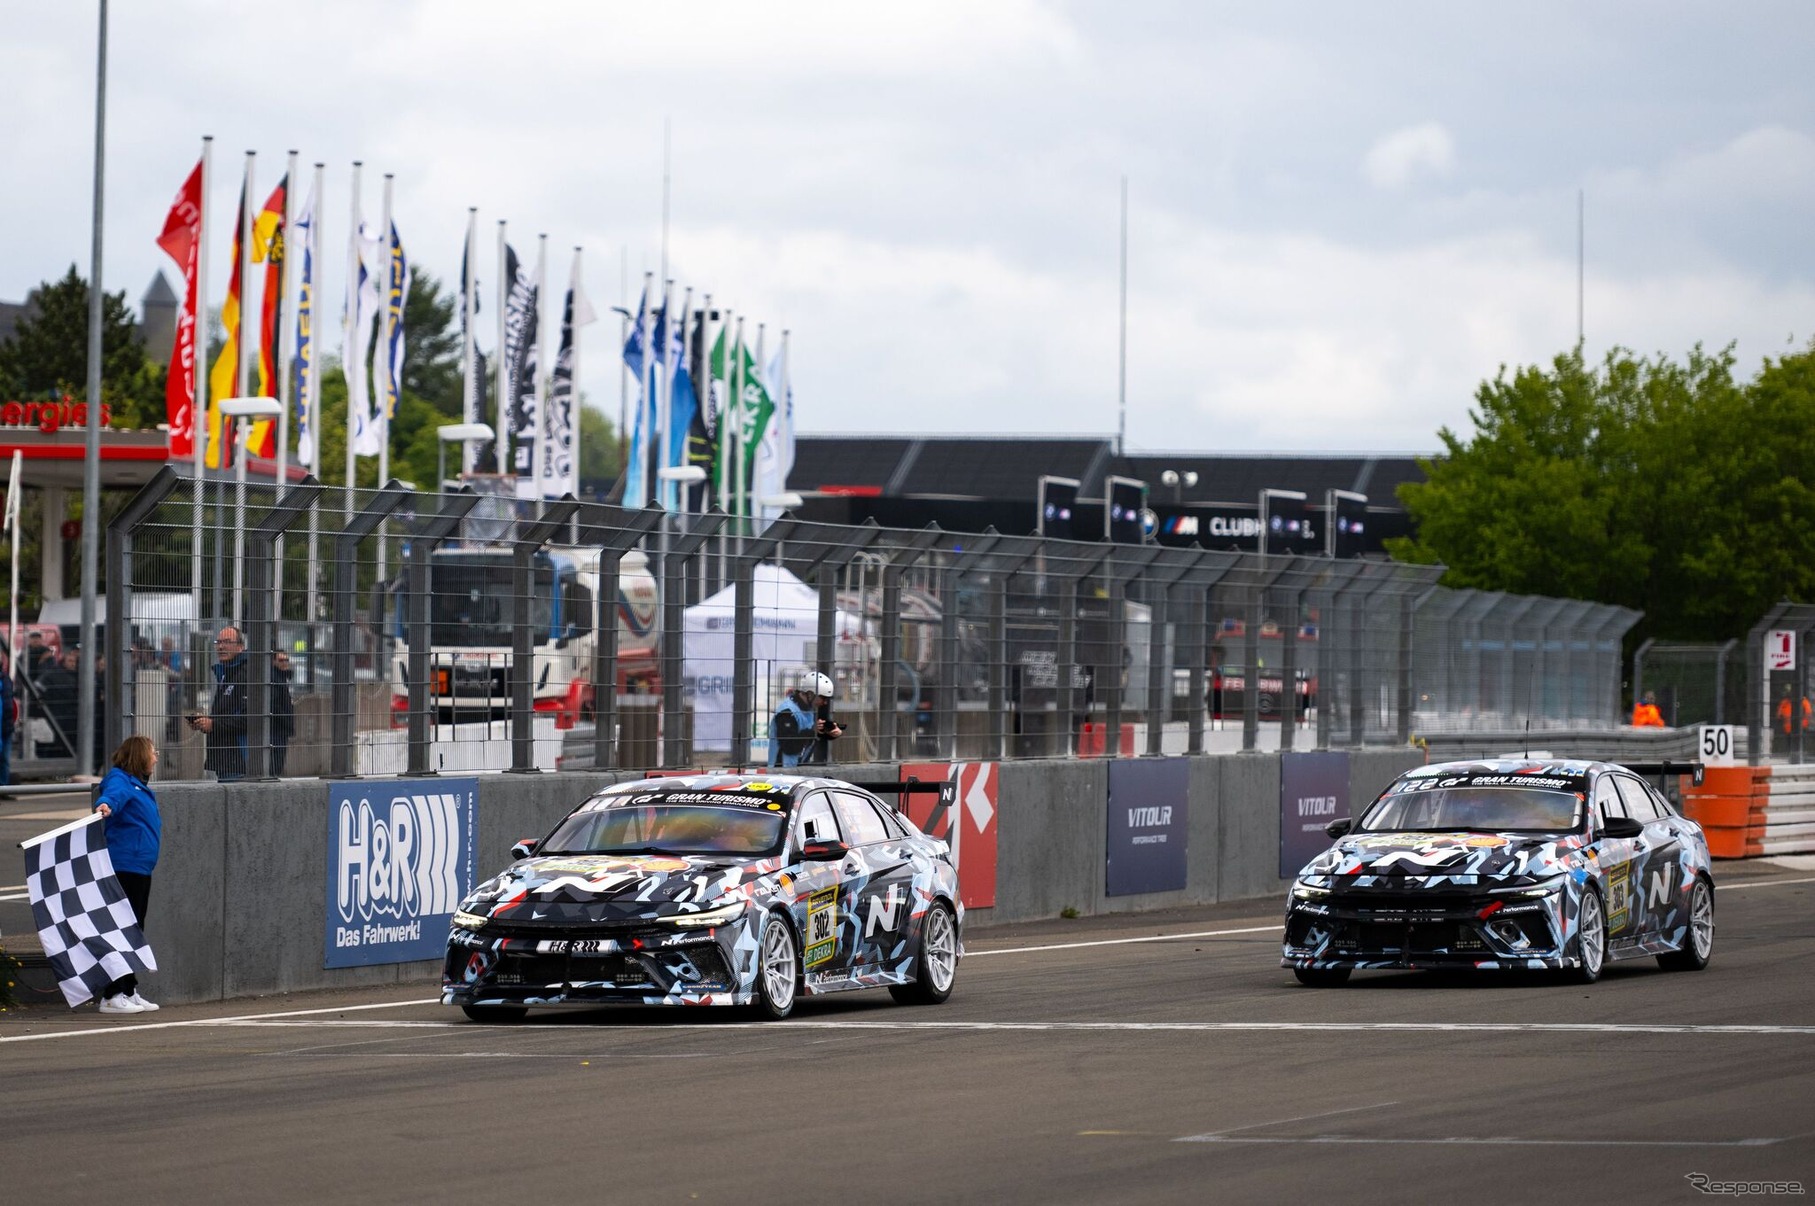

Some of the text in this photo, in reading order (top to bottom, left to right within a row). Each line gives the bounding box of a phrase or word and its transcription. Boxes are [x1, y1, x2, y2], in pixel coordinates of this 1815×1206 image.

[0, 394, 112, 433] ergies
[1703, 728, 1729, 756] 50
[1509, 776, 1568, 787] TURISMO
[1695, 769, 1703, 782] N
[666, 793, 767, 805] GRAN TURISMO
[942, 787, 952, 801] N
[1128, 805, 1172, 828] VITOUR
[1298, 796, 1337, 817] VITOUR
[1648, 861, 1672, 910] N
[865, 883, 899, 938] N
[1502, 905, 1539, 913] Performance
[336, 920, 420, 948] Das Fahrwerk!
[814, 911, 830, 941] 302
[673, 935, 715, 946] Performance
[813, 944, 832, 961] DEKRA
